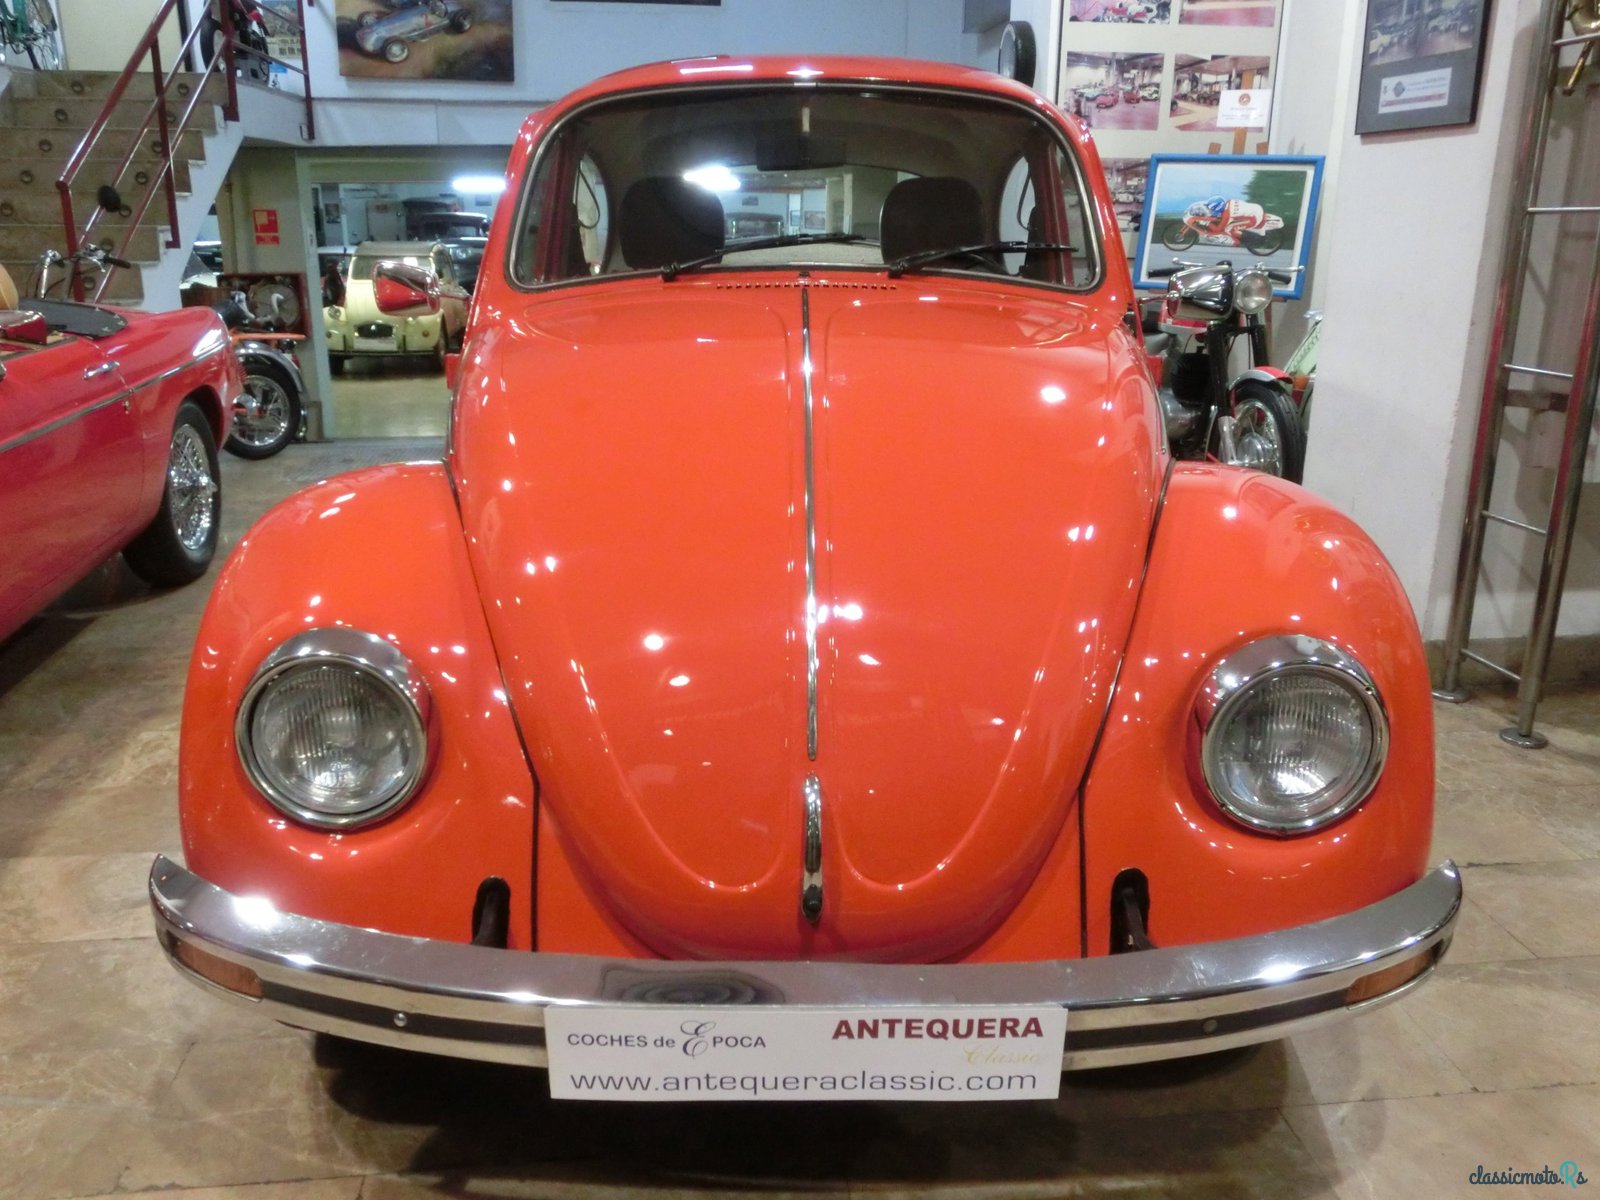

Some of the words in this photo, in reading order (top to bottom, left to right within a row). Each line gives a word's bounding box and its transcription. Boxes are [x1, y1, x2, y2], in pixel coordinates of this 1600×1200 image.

[567, 1033, 648, 1048] COCHES
[653, 1035, 676, 1048] de
[832, 1017, 1044, 1041] ANTEQUERA
[570, 1070, 1037, 1096] www.antequeraclassic.com
